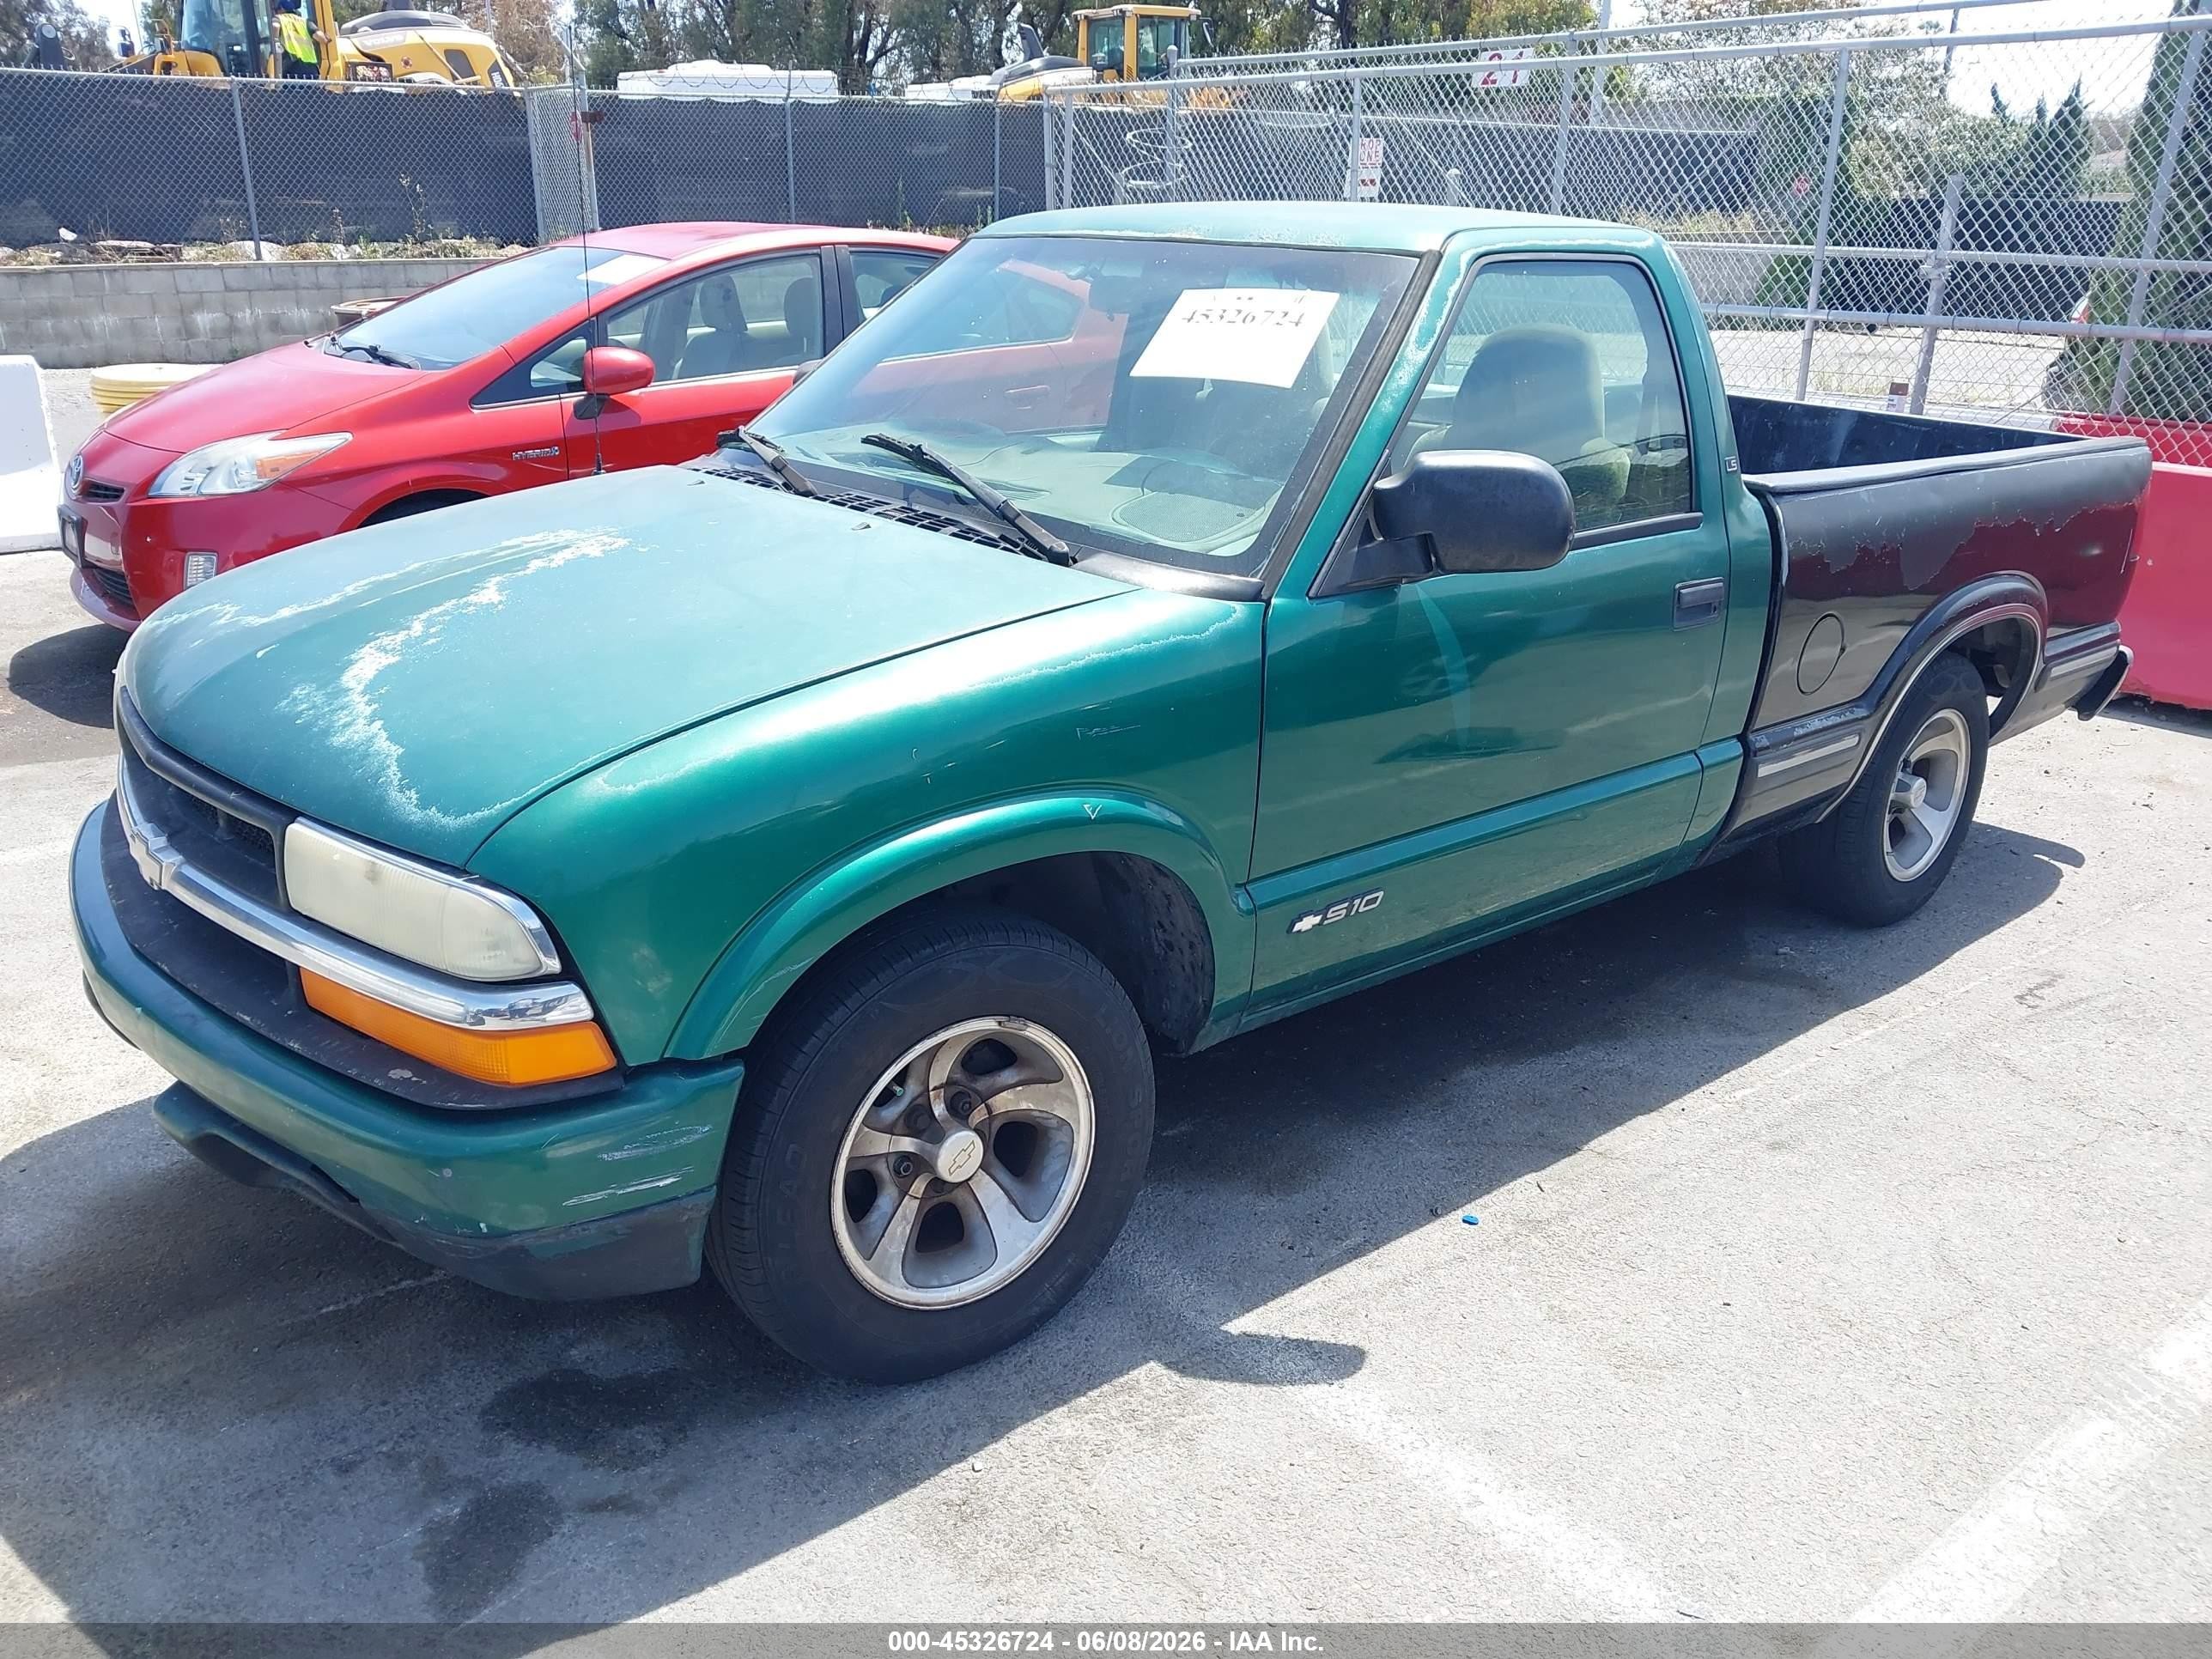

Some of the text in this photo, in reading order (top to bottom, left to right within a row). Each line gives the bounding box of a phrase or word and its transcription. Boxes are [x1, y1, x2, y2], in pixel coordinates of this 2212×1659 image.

[1359, 138, 1381, 151] ROP
[1359, 151, 1379, 162] ONE
[1182, 308, 1305, 327] 45326724
